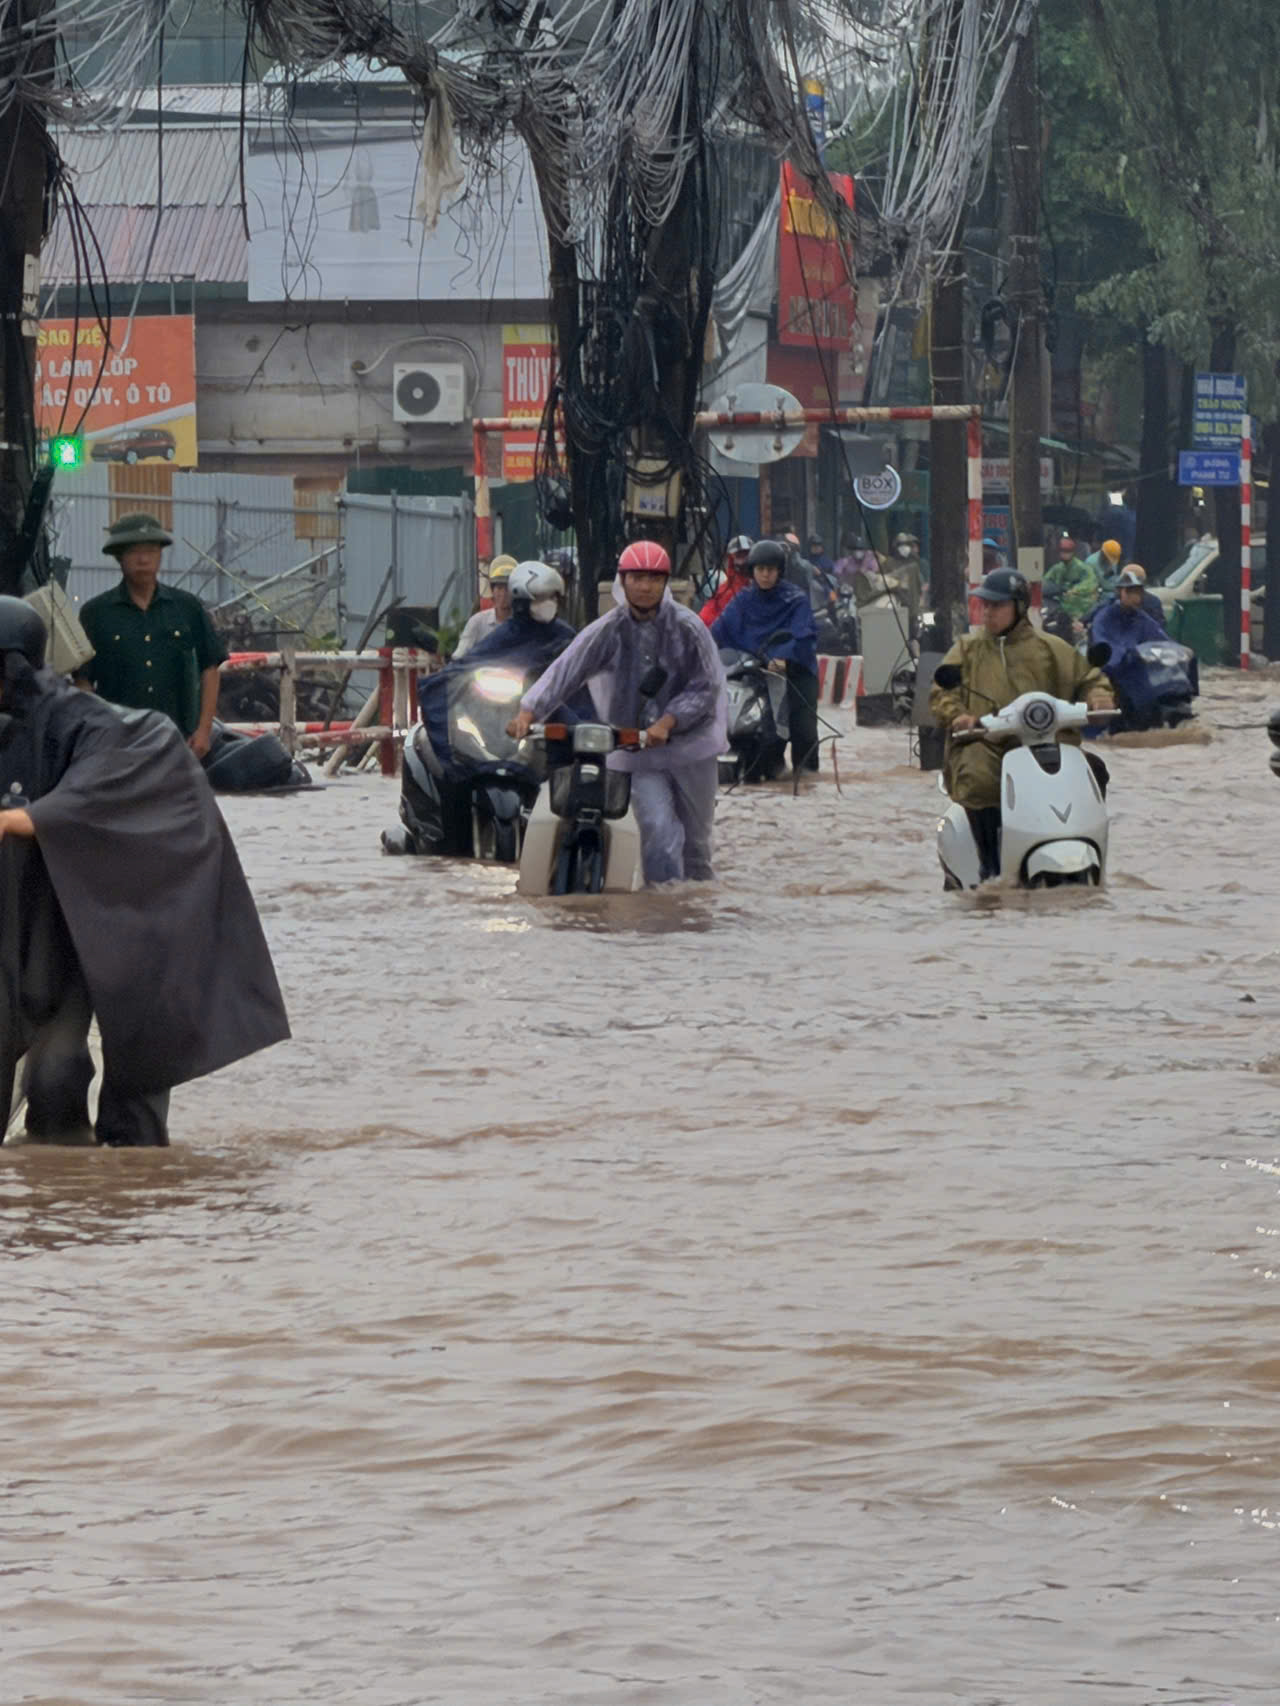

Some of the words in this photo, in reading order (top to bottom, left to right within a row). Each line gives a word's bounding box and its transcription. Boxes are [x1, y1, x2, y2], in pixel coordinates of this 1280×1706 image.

[36, 327, 70, 346] SAO
[49, 355, 93, 377] LÀM
[99, 354, 137, 377] LỐP
[127, 382, 140, 404] Ô
[145, 381, 171, 404] TÔ
[862, 478, 893, 489] BOX
